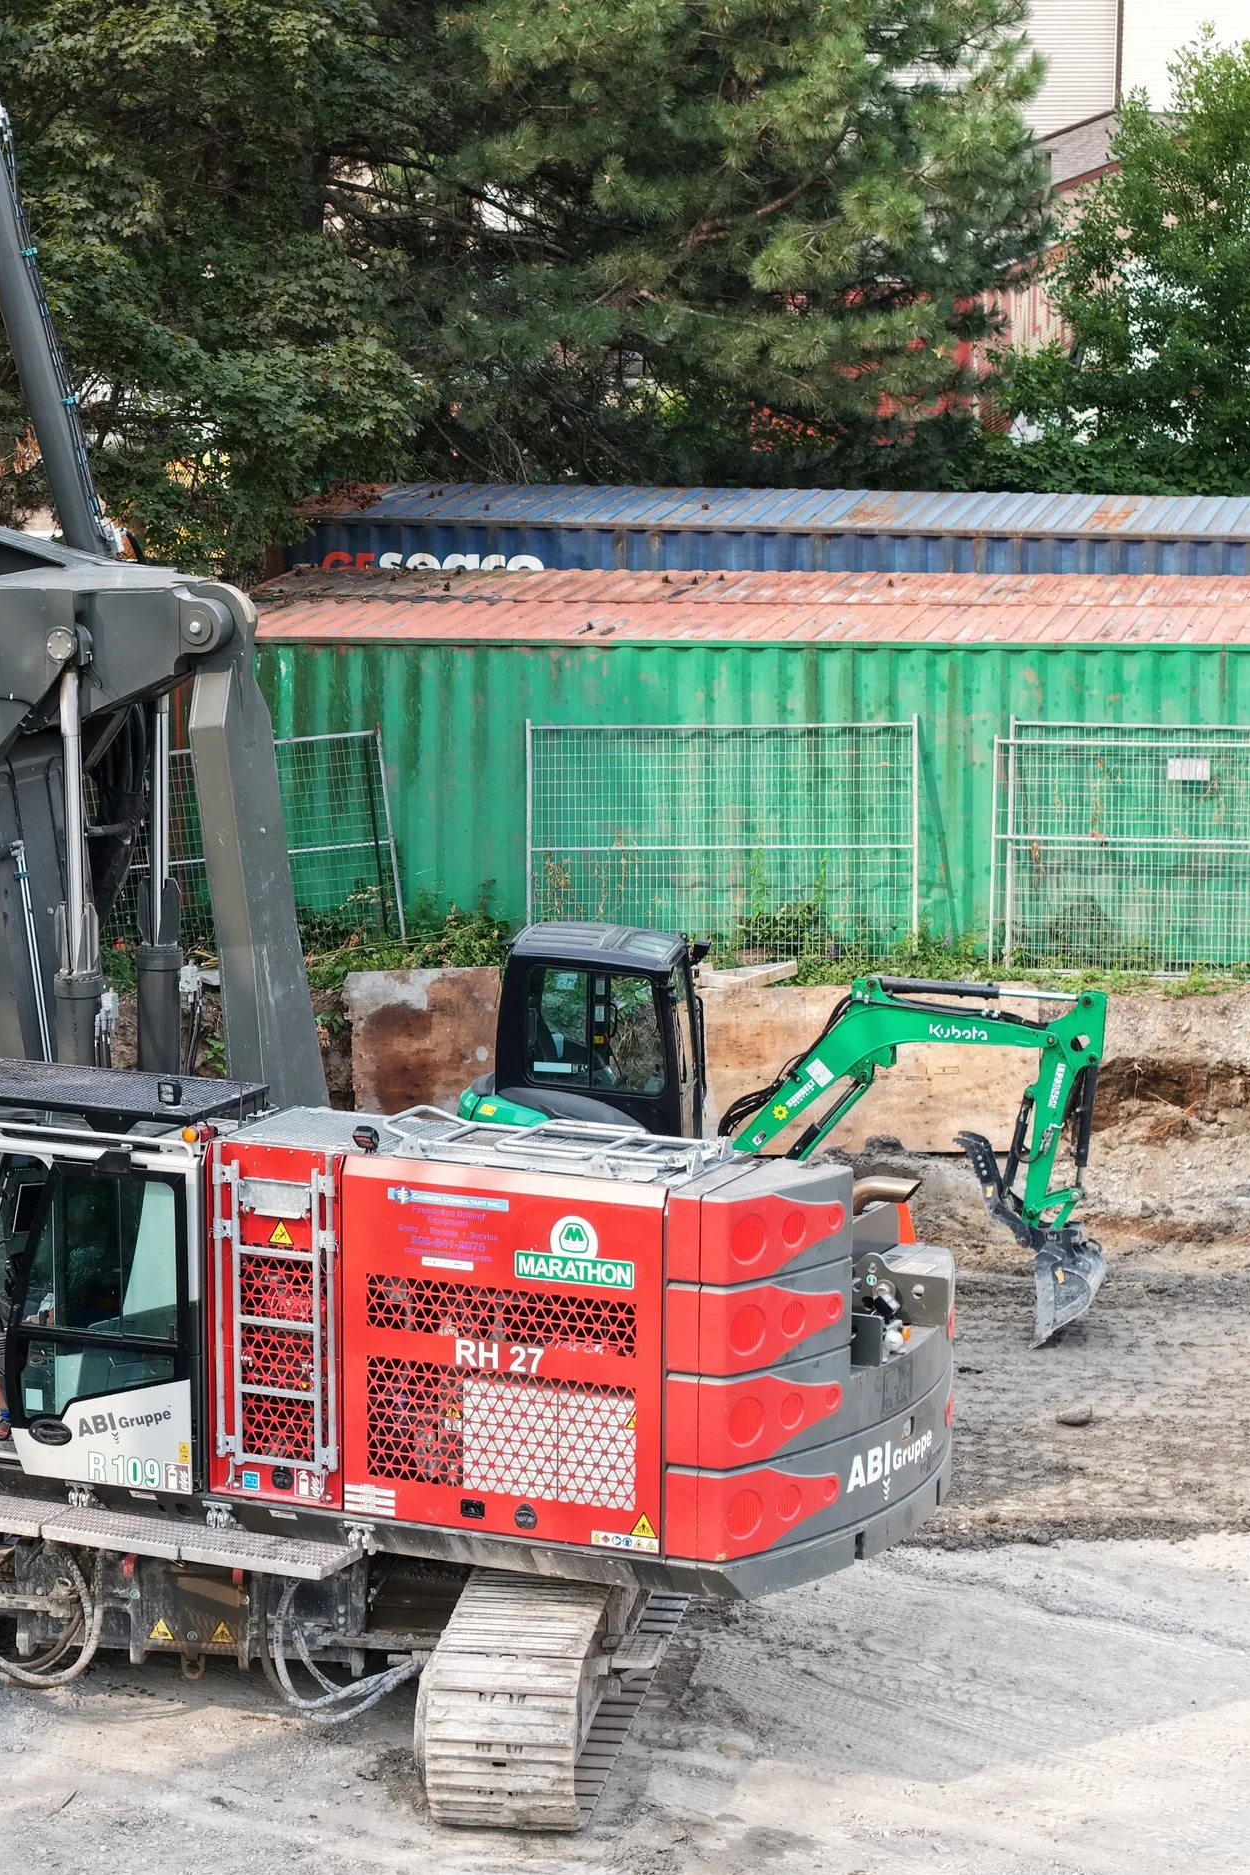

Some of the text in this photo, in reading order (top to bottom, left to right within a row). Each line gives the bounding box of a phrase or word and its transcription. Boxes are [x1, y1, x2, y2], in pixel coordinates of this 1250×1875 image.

[929, 1023, 988, 1041] Kubota
[785, 1079, 815, 1107] SUNBELT
[412, 1206, 485, 1221] Foundation Drilling
[427, 1216, 468, 1228] Equipment
[397, 1224, 498, 1241] Sales Rentals Service
[518, 1255, 631, 1285] MARATHON
[455, 1339, 544, 1374] RH 27
[78, 1410, 172, 1437] ABI Gruppe
[88, 1451, 161, 1489] R 109
[846, 1440, 891, 1493] ABI
[892, 1430, 932, 1470] Gruppe
